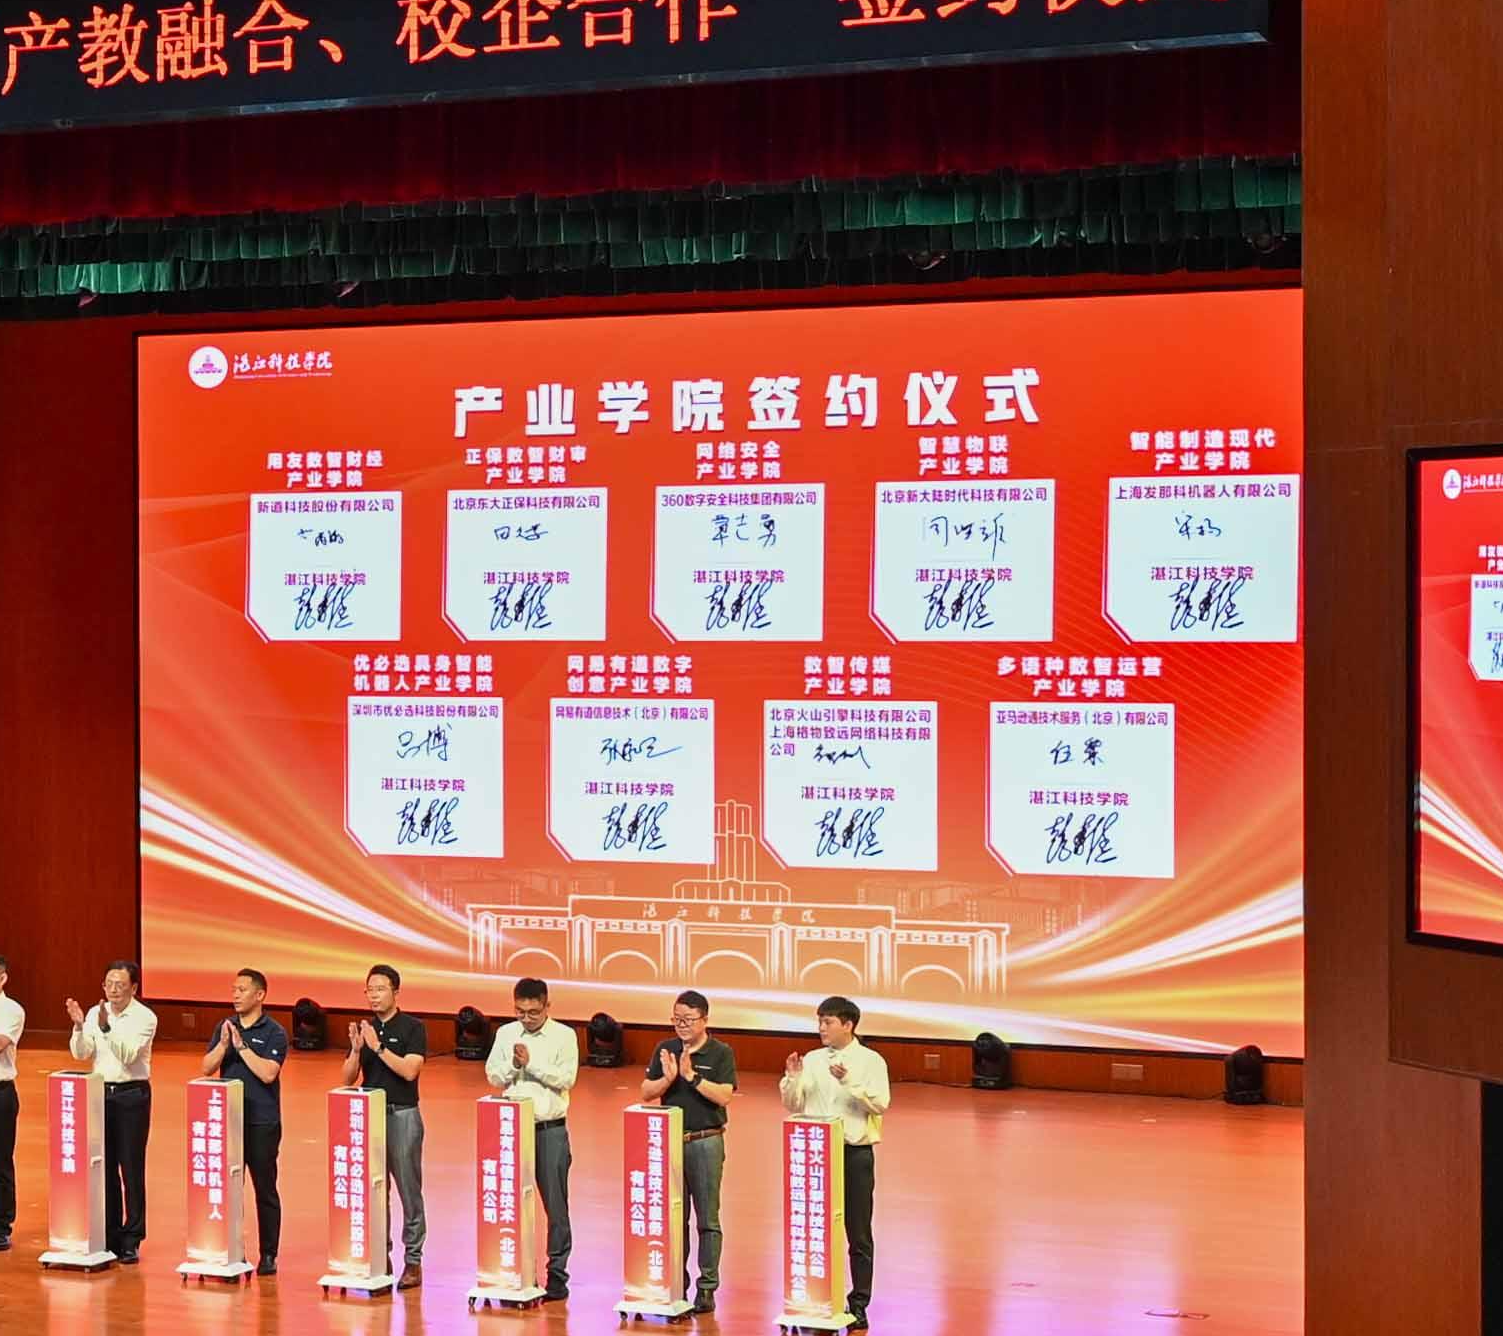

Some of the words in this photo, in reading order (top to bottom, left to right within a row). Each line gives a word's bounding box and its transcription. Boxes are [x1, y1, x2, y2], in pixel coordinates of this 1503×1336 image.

[452, 367, 1040, 438] 产业学院签约仪式
[918, 435, 1009, 454] 智慧物联
[1130, 429, 1276, 451] 智能制造现代
[696, 441, 781, 459] 网络安全
[918, 455, 1009, 475] 产业学院
[1155, 451, 1251, 471] 产业学院
[286, 470, 363, 488] 产业学院
[485, 466, 567, 485] 产业学院
[696, 461, 781, 480] 产业学院
[661, 492, 817, 507] 360数字安全科技集团有限公司
[881, 487, 1049, 503] 北京新大陆时代科技有限公司
[1115, 483, 1292, 501] 上海发那科机器人有限公司
[256, 499, 395, 514] 新道科技股份有限公司
[452, 495, 601, 511] 北京东大正保科技有限公司
[284, 572, 367, 587] 湛江科技学院
[483, 570, 570, 585] 湛江科技学院
[693, 569, 785, 584] 湛江科技学院
[915, 567, 1012, 584] 湛江科技学院
[1151, 565, 1254, 582] 湛江科技学院
[353, 674, 493, 693] 机器人产业学院
[567, 674, 693, 694] 创意产业学院
[804, 677, 892, 696] 产业学院
[1033, 679, 1125, 698] 产业学院
[351, 704, 500, 719] 深圳市优必选科技股份有限公司
[770, 743, 796, 757] 公司
[380, 777, 466, 792] 湛江科技学院
[584, 781, 675, 797] 湛江科技学院
[800, 785, 896, 802] 湛江科技学院
[1029, 789, 1129, 807] 湛江科技学院
